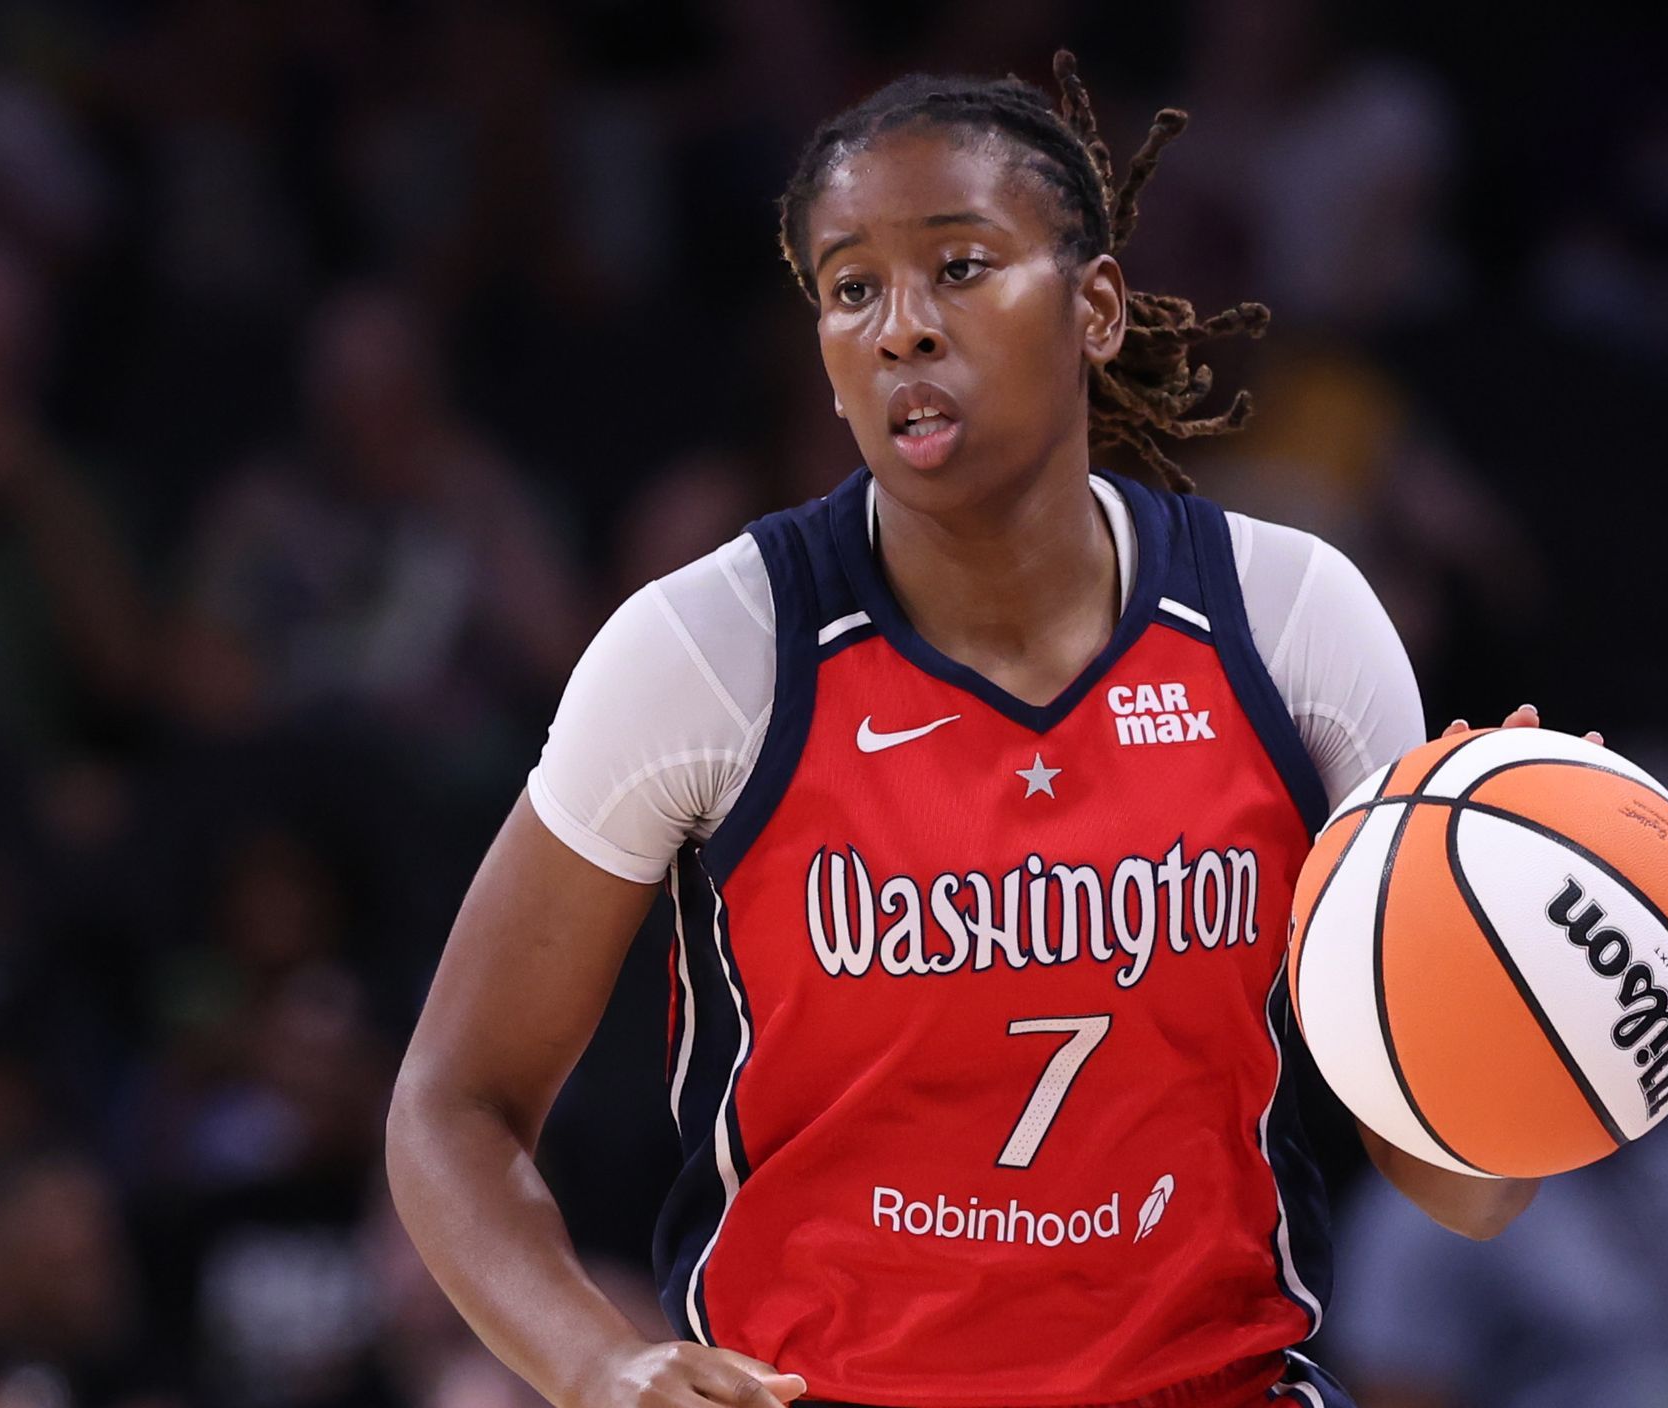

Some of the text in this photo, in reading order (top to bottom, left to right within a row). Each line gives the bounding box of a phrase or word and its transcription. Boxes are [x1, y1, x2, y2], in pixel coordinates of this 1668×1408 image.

[1107, 682, 1189, 715] CAR
[1115, 710, 1217, 746] max
[995, 1012, 1112, 1170] 7
[872, 1186, 1120, 1248] Robinhood
